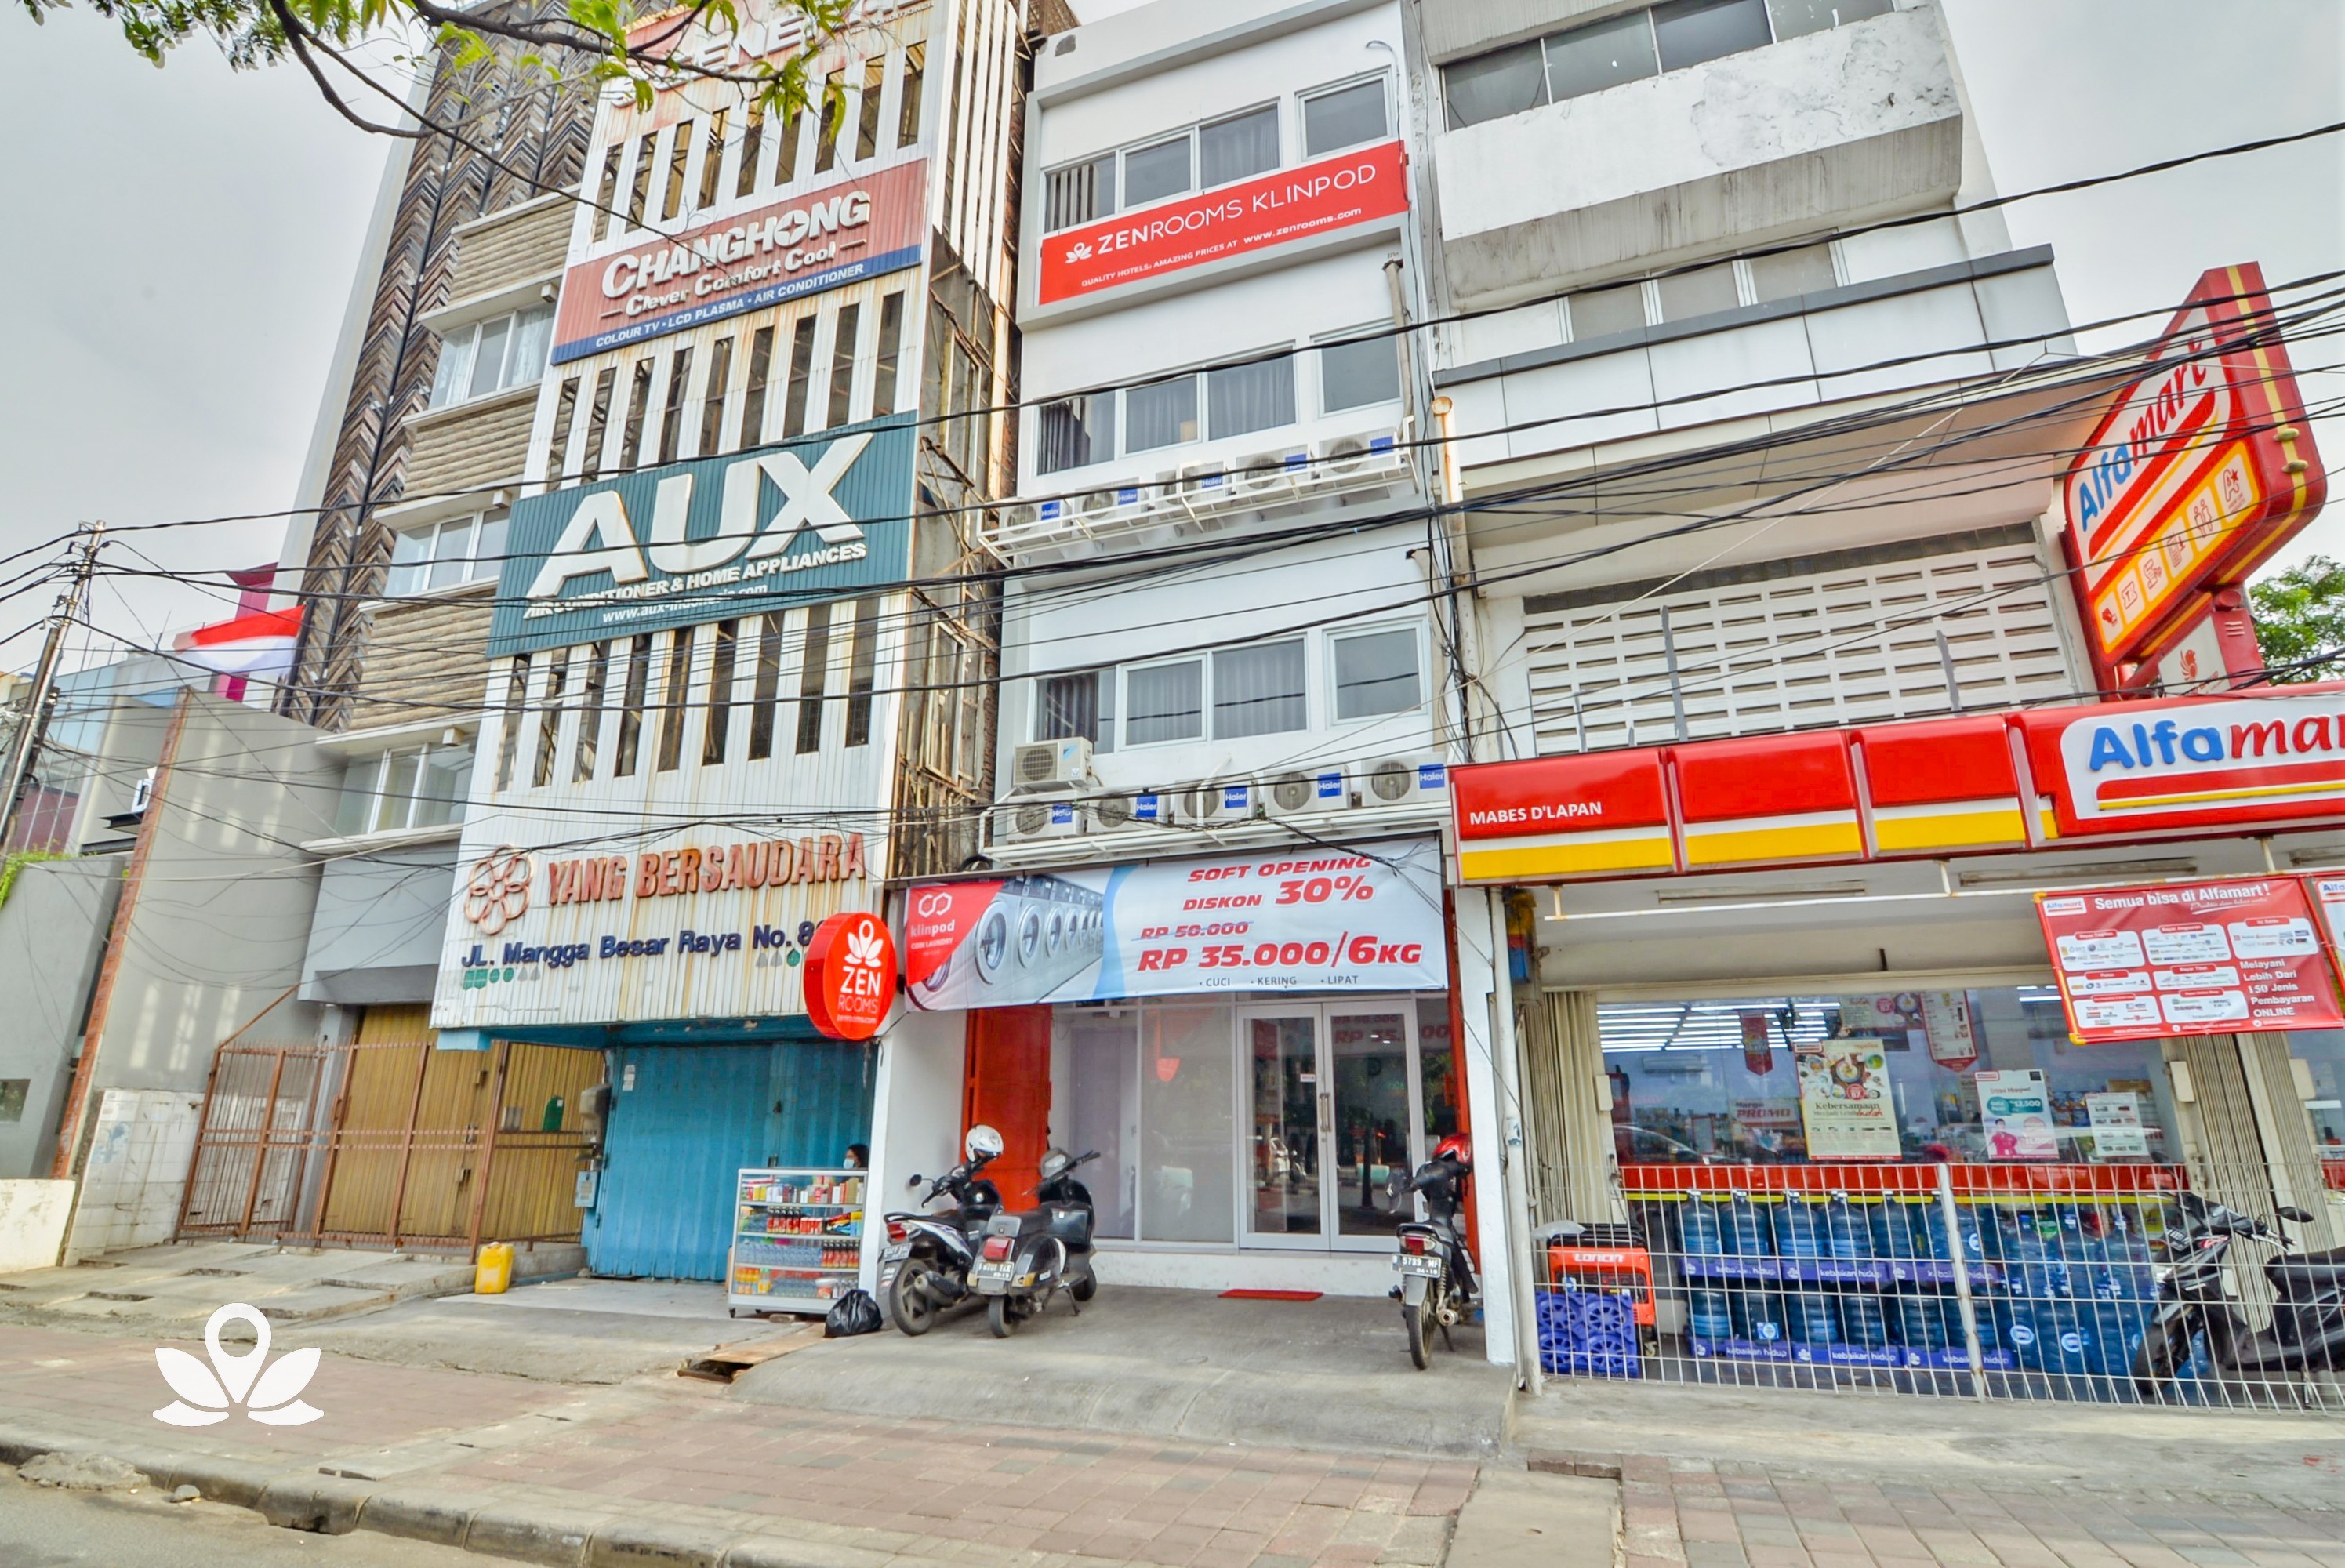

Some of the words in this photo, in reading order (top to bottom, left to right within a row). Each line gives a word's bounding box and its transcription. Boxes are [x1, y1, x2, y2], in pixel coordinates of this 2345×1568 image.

[1098, 198, 1243, 256] ZENROOMS
[1252, 163, 1376, 212] KLINPOD
[601, 191, 870, 299] CHANGHONG
[1081, 270, 1116, 288] QUALITY
[1153, 252, 1194, 268] AMAZING
[1195, 244, 1225, 260] PRICES
[1227, 240, 1239, 249] AT
[1243, 207, 1363, 245] www.zenrooms.com
[626, 288, 687, 317] Clever
[694, 260, 781, 297] Comfort
[784, 241, 836, 272] Cool
[596, 326, 641, 347] COLOUR
[644, 321, 659, 335] TV
[668, 313, 692, 328] LCD
[695, 299, 744, 321] PLASMA
[754, 289, 775, 304] AIR
[777, 263, 864, 298] CONDITIONER
[2079, 336, 2207, 532] Alfamart
[1201, 476, 1223, 488] Haier
[526, 432, 874, 598] AUX
[670, 577, 684, 593] &
[687, 565, 739, 591] HOME
[742, 541, 867, 581] APPLIANCES
[2089, 713, 2345, 771] Alfama
[1137, 802, 1157, 811] Haier
[1225, 792, 1247, 802] Haier
[1318, 781, 1341, 791] Haier
[1420, 772, 1444, 782] Haier
[1470, 808, 1527, 825] MABES
[1530, 801, 1603, 820] D'LAPAN
[548, 855, 626, 906] YANG
[635, 833, 866, 898] BERSAUDARA
[1187, 864, 1251, 883] SOFT
[1257, 855, 1373, 878] OPENING
[1182, 894, 1263, 911] DISKON
[1275, 875, 1374, 906] 30%
[2046, 900, 2082, 909] Alfamart
[2094, 896, 2145, 910] Semua
[2147, 892, 2180, 906] bisa
[2181, 889, 2196, 902] di
[910, 919, 956, 937] klinpod
[1141, 925, 1169, 940] RP
[1174, 921, 1250, 938] 50.000
[461, 944, 495, 967] JL.
[502, 942, 591, 969] Mangga
[599, 935, 670, 959] Besar
[677, 930, 742, 958] Raya
[797, 920, 826, 947] 8
[1138, 947, 1188, 972] RP
[1198, 931, 1423, 969] 35.000/6KG
[2239, 958, 2285, 971] Melayani
[2243, 971, 2273, 982] Lebih
[2275, 969, 2297, 979] Dari
[840, 965, 881, 997] ZEN
[1205, 977, 1231, 988] CUCI
[1257, 976, 1298, 986] KERING
[1327, 975, 1359, 985] LIPAT
[2248, 984, 2268, 994] 150
[2271, 982, 2299, 992] Jenis
[837, 994, 879, 1014] ROOMS
[2251, 994, 2315, 1006] Pembayaran
[2253, 1007, 2296, 1018] ONLINE
[1737, 1109, 1791, 1118] PROMO
[1815, 1102, 1880, 1110] Kebersamaan
[1726, 1345, 1762, 1356] kebaikan
[1763, 1347, 1788, 1358] hidup
